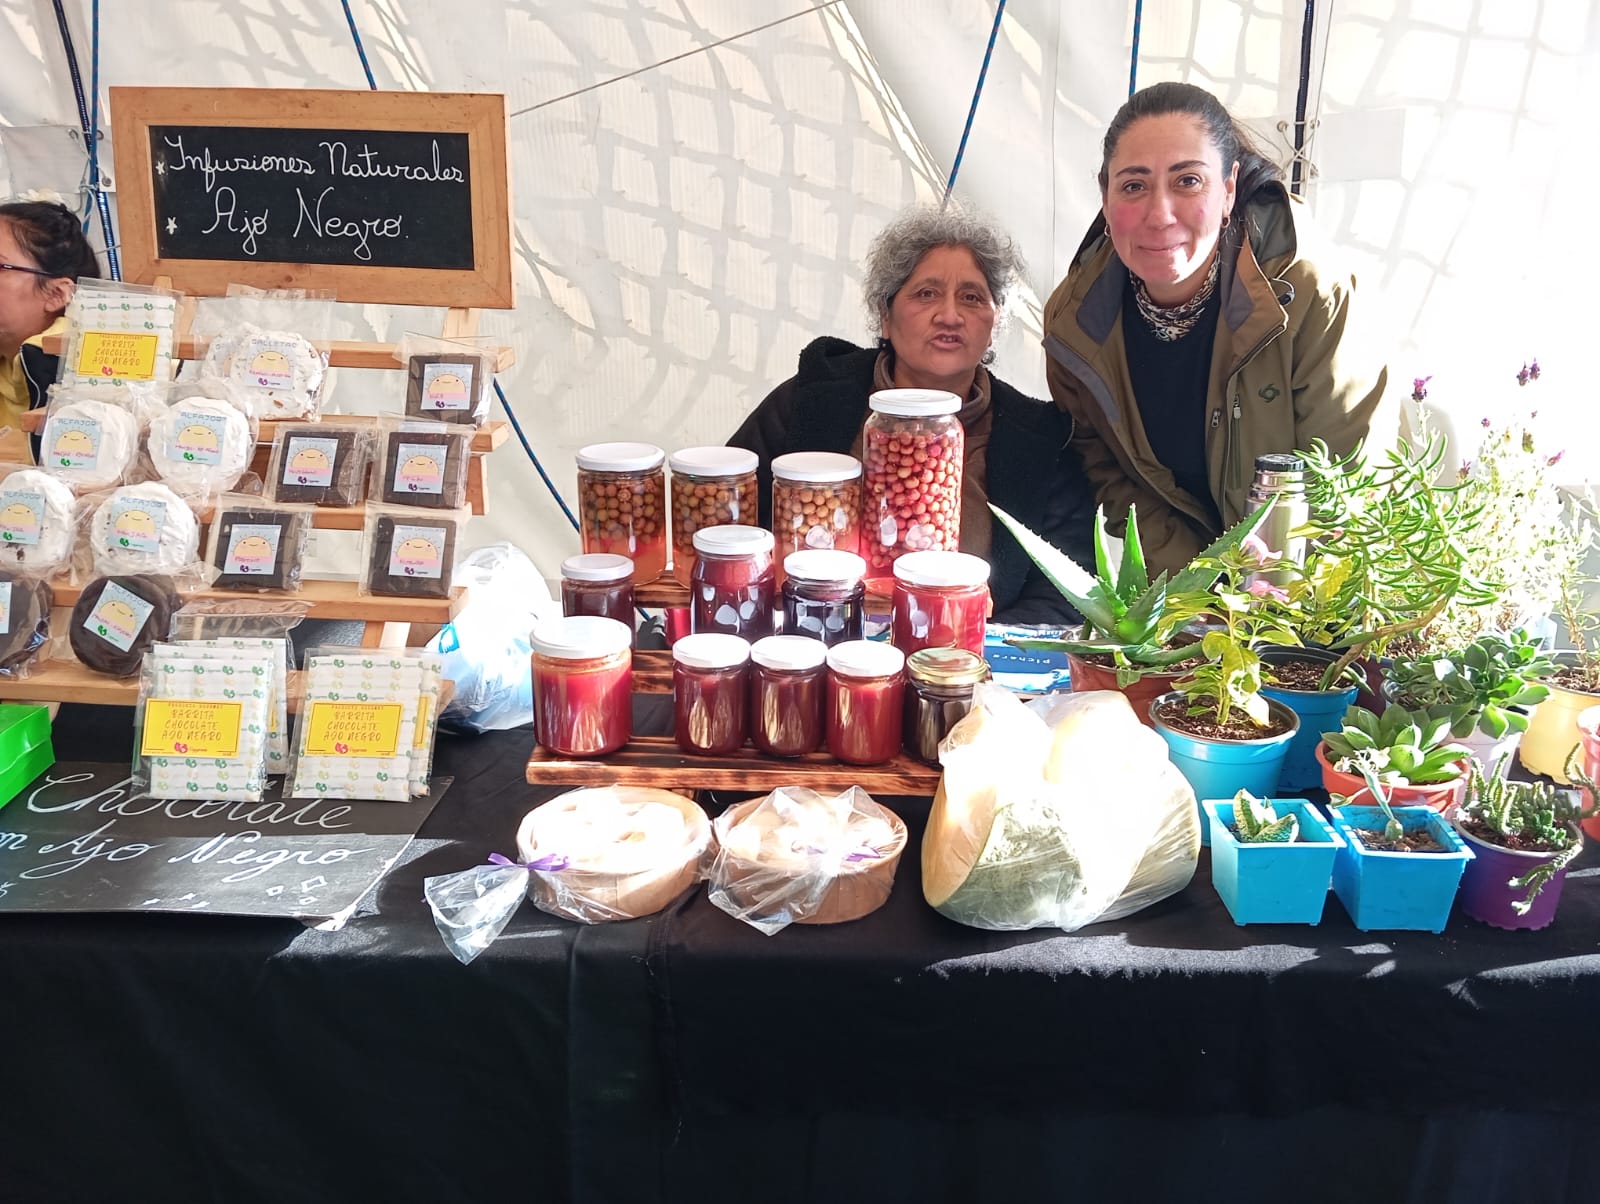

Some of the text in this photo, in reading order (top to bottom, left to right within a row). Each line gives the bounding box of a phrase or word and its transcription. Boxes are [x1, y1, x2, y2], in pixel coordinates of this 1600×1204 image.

[319, 140, 465, 183] Naturales
[202, 186, 269, 256] Ajo
[172, 709, 214, 720] BARRITA
[335, 711, 375, 721] BARRITA
[165, 719, 218, 731] CHOCOLATE
[327, 721, 377, 731] CHOCOLATE
[187, 731, 222, 741] NEGRO
[347, 731, 382, 742] NEGRO
[168, 831, 376, 884] Negro
